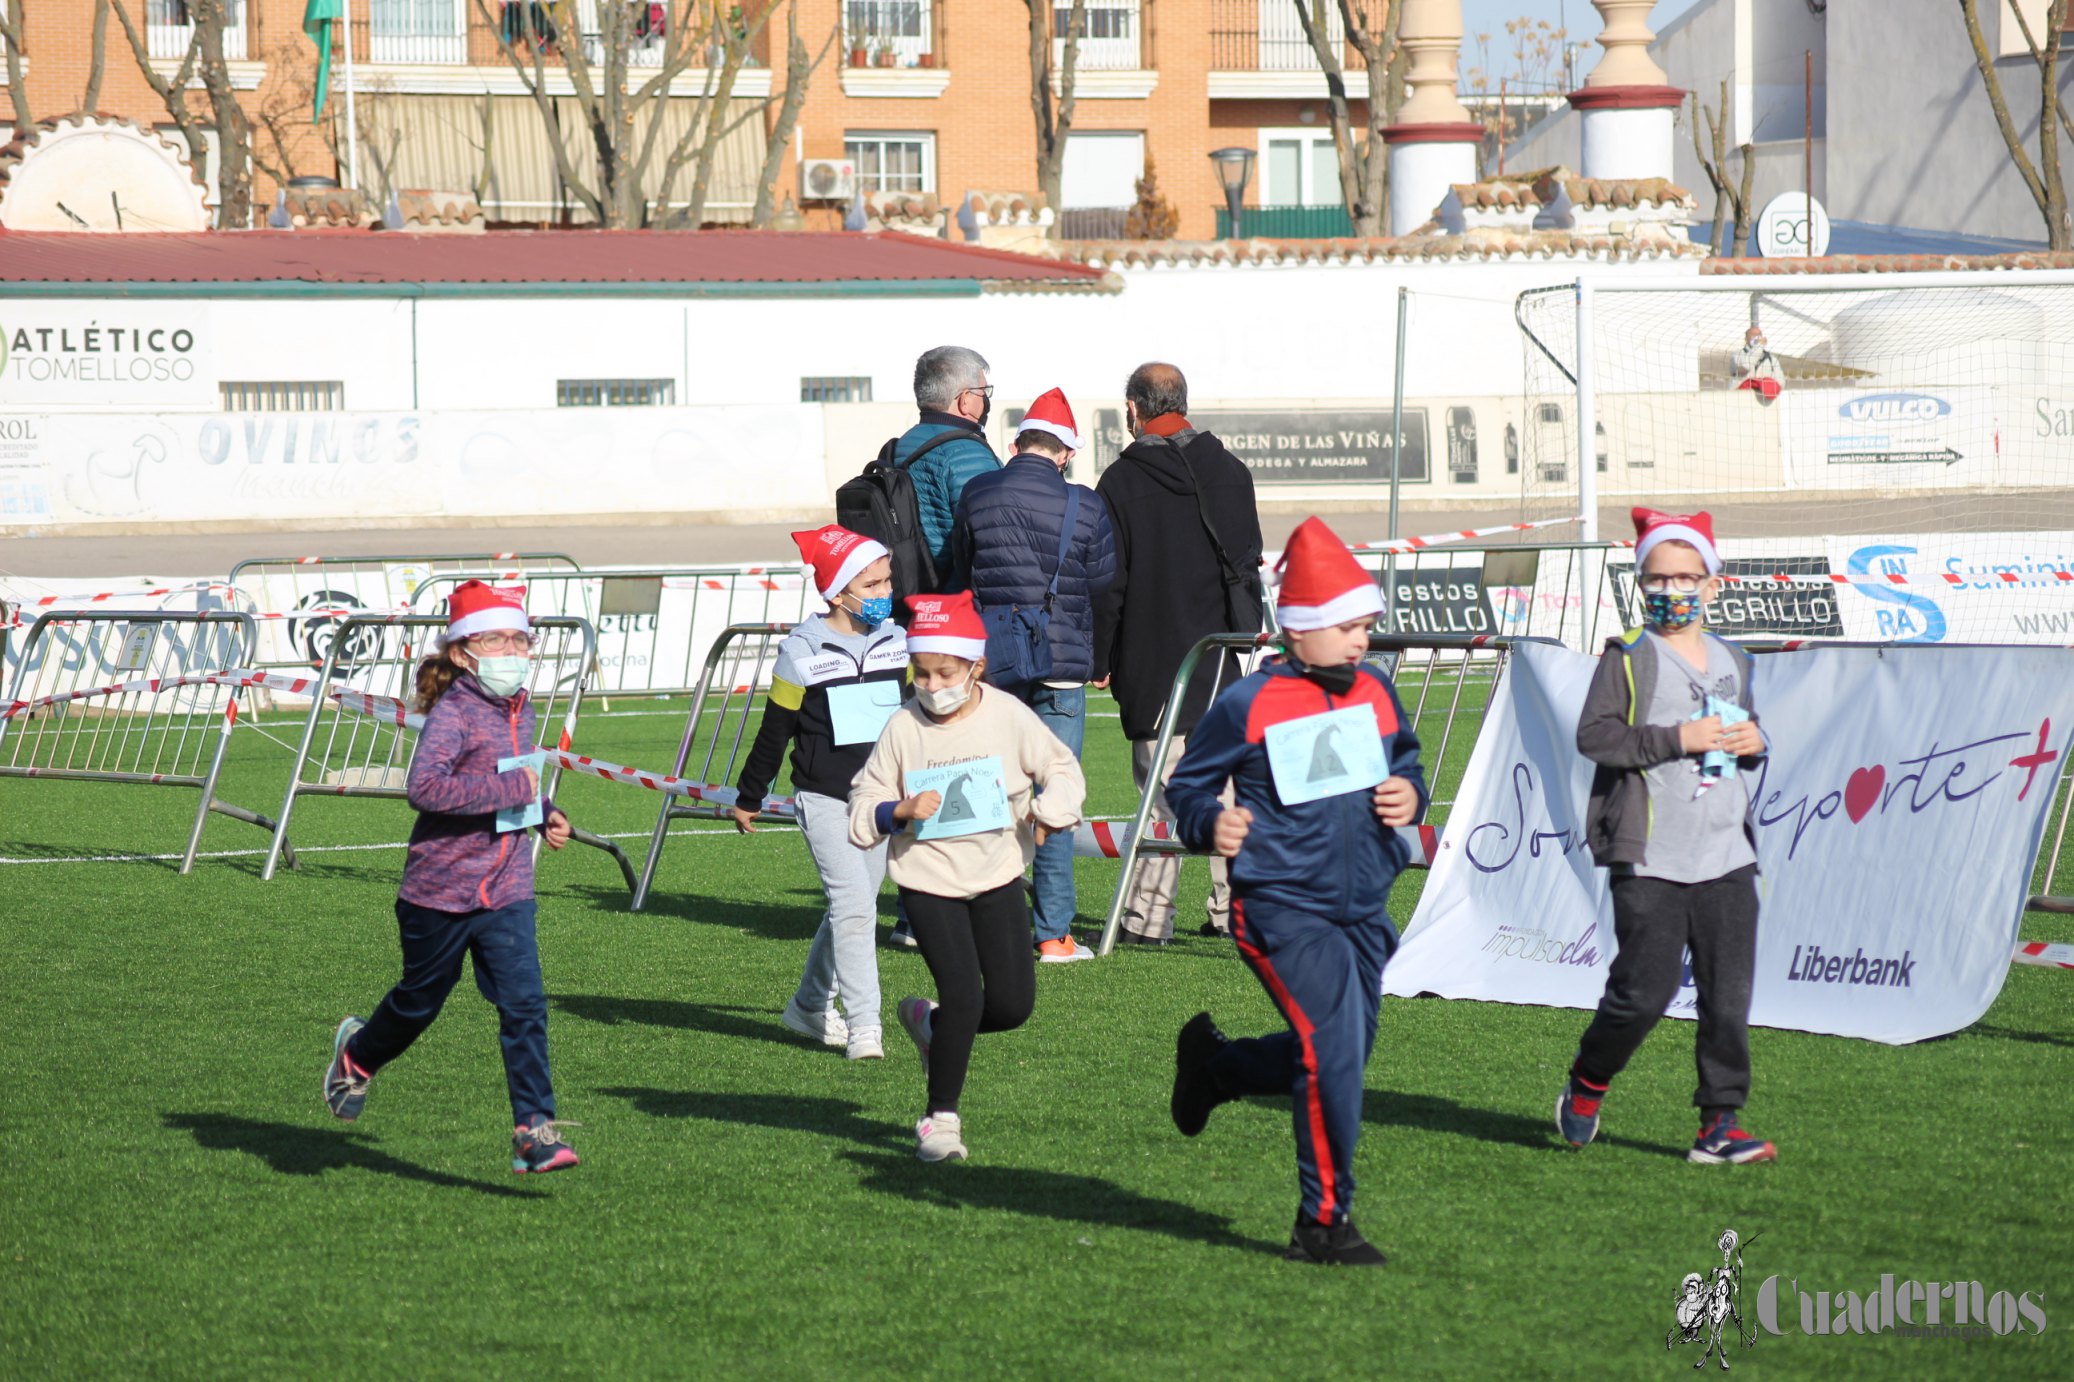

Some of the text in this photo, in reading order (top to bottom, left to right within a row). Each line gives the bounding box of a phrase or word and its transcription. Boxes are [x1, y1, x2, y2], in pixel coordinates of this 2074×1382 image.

[11, 320, 195, 353] ATLÉTICO
[10, 356, 195, 381] TOMELLOSO
[1849, 397, 1940, 422] VULCO
[1216, 433, 1271, 450] RGEN
[1276, 433, 1300, 450] DE
[1305, 433, 1335, 449] LAS
[1298, 457, 1307, 467] Y
[1310, 456, 1368, 467] ALMAZARA
[1945, 554, 2074, 590] Sumini
[1380, 582, 1479, 603] estos
[1537, 593, 1613, 609] TOTL
[1703, 597, 1832, 625] EGRILLO
[2013, 611, 2074, 635] ww
[891, 649, 907, 658] ZON
[913, 773, 945, 789] Carrera
[950, 800, 961, 816] 5
[1788, 944, 1918, 988] Liberbank
